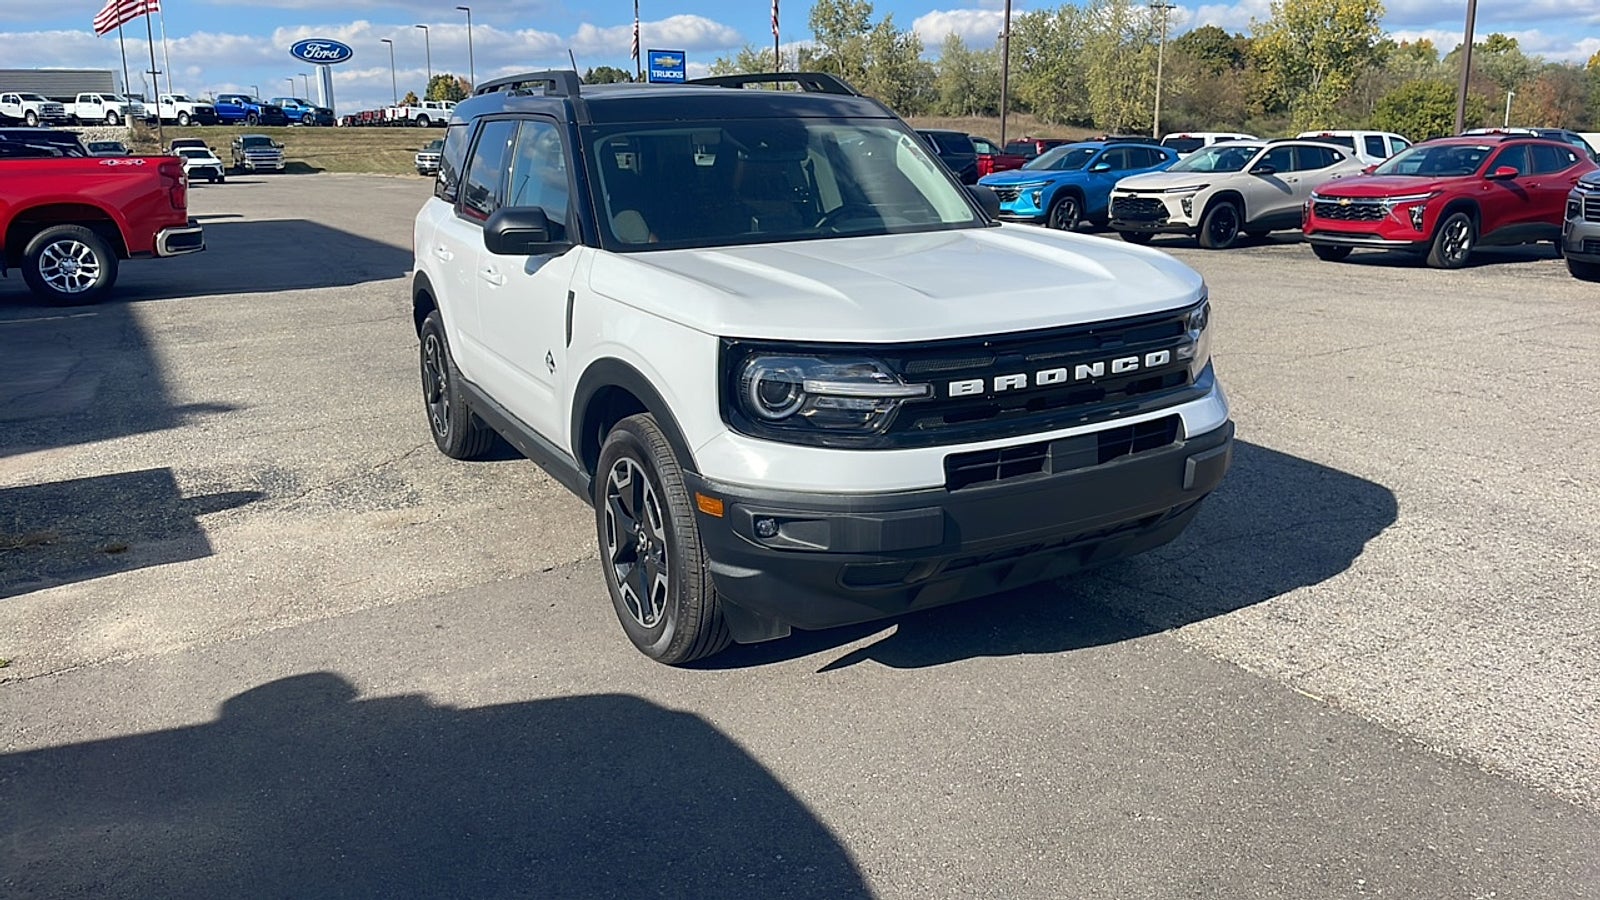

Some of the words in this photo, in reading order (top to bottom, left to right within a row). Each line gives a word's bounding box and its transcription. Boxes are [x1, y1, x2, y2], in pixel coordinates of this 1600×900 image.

[303, 43, 340, 58] Ford
[652, 70, 683, 78] TRUCKS
[949, 350, 1170, 397] BRONCO
